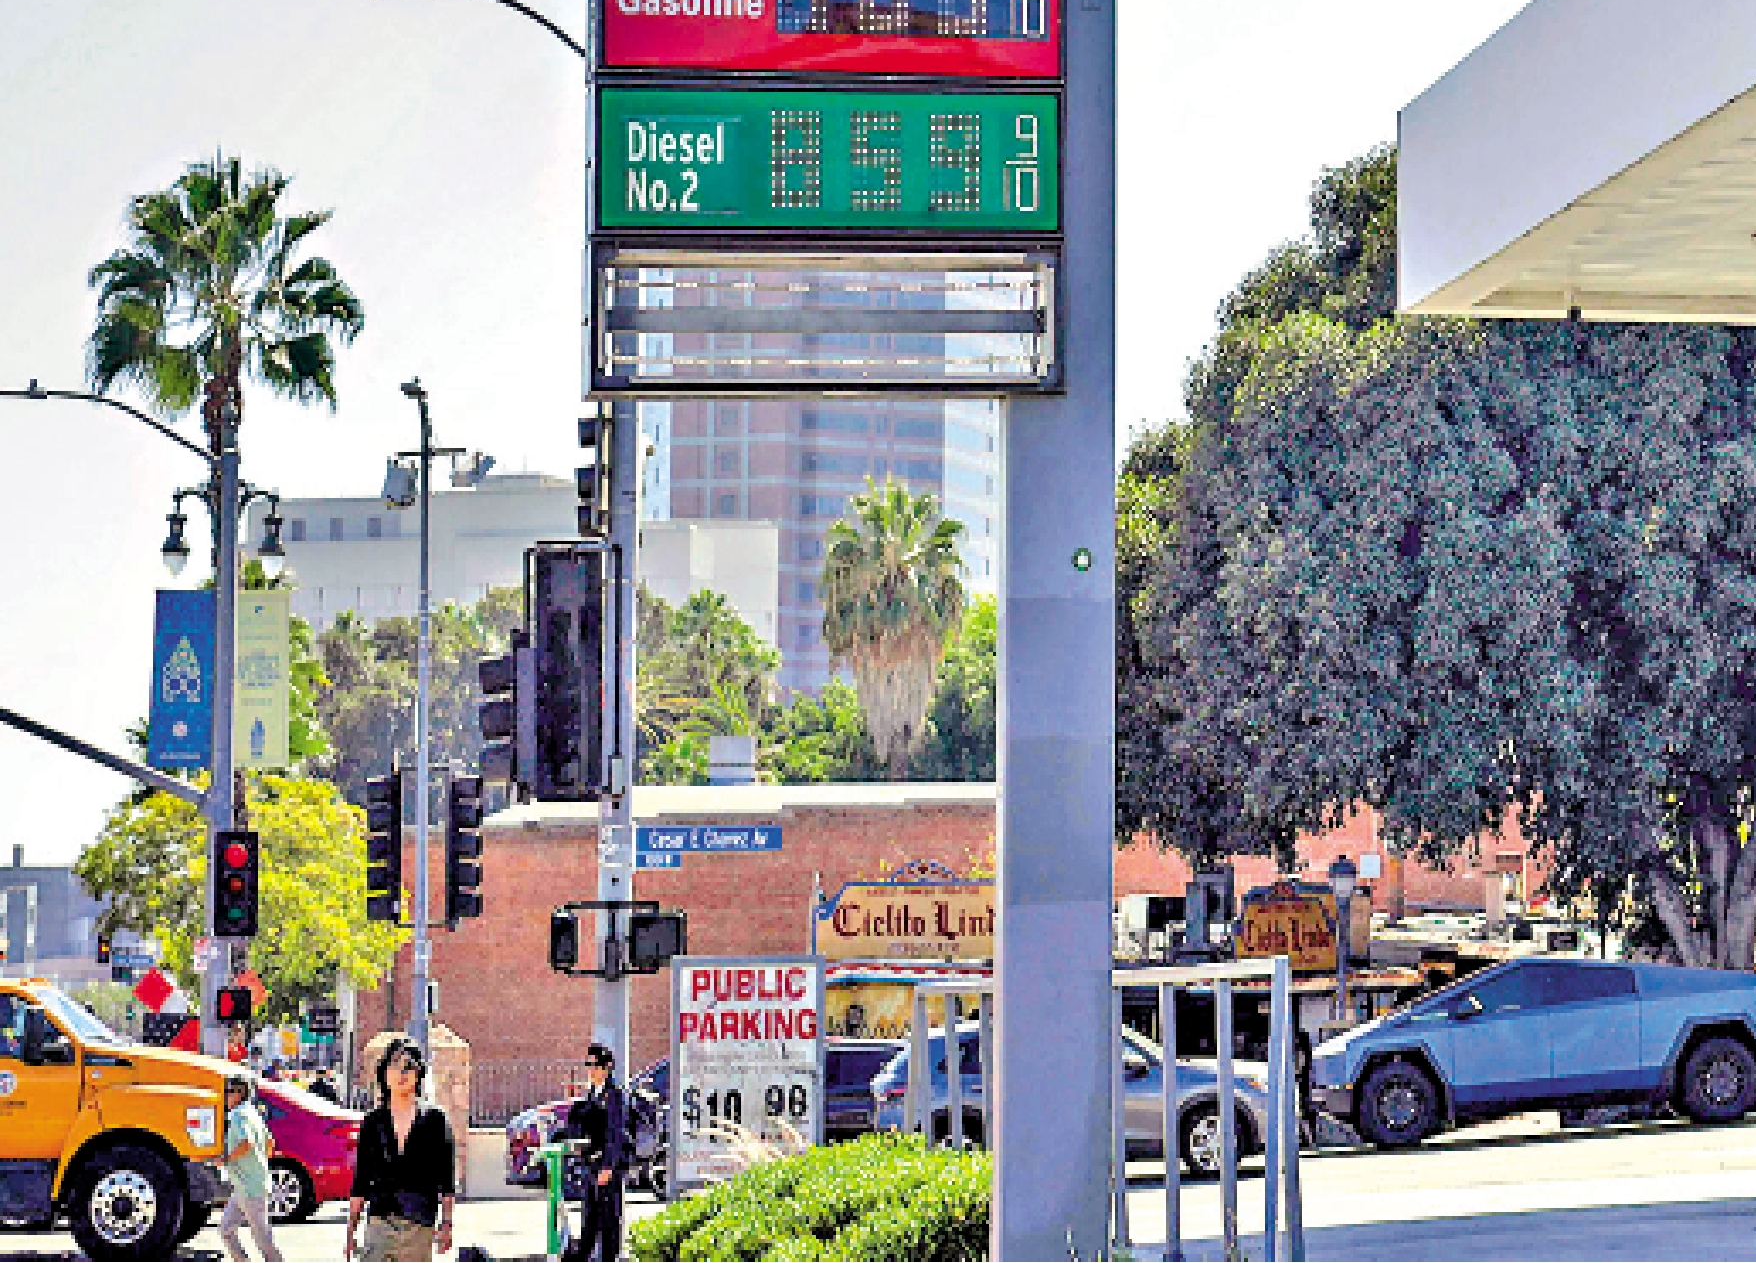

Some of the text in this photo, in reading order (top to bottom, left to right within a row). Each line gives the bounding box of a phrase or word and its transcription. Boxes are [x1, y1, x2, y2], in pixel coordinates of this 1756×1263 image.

[625, 121, 725, 163] Diesel
[625, 168, 699, 213] No.2
[691, 968, 807, 1002] PUBLIC
[679, 1009, 817, 1041] PARKING
